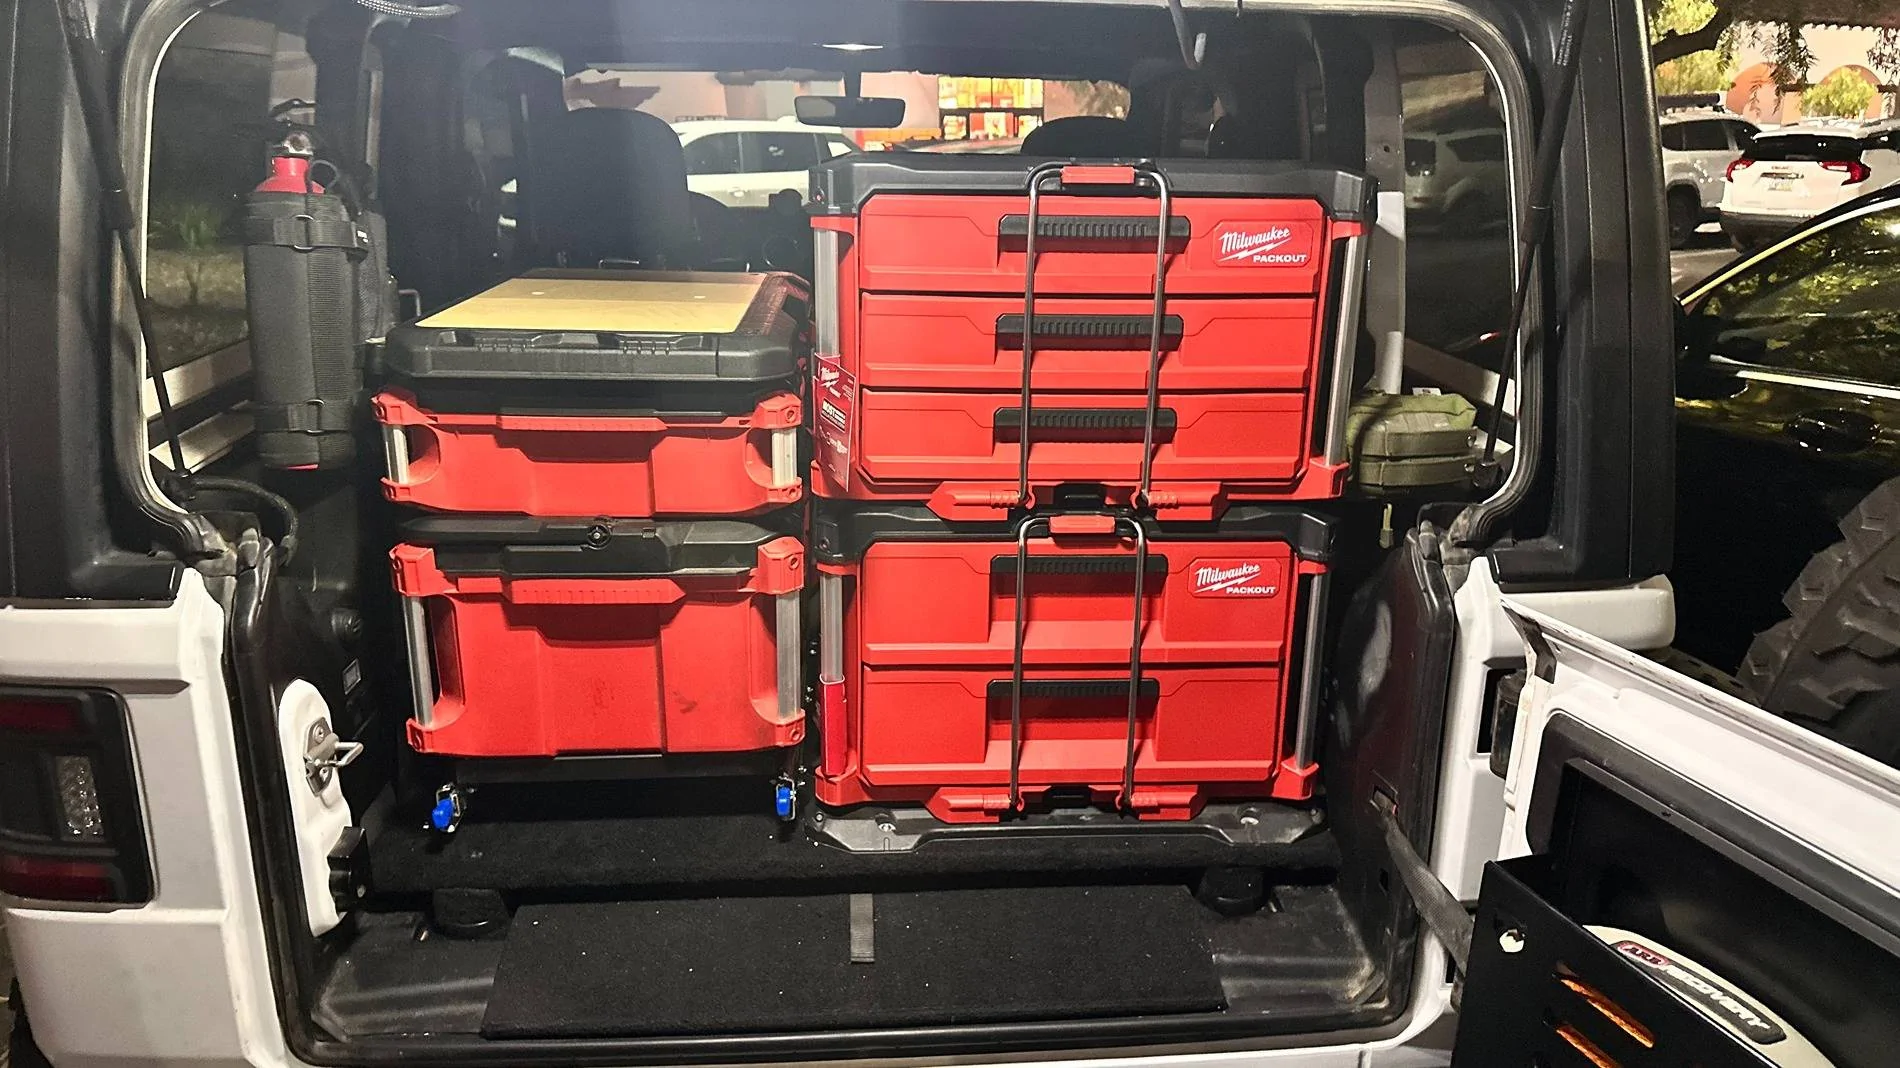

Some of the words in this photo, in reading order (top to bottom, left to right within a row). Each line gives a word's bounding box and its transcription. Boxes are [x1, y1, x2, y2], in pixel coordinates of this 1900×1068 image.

[1219, 226, 1291, 254] Milwaukee
[1253, 254, 1307, 263] PACKOUT
[1194, 563, 1261, 587] Milwaukee
[1226, 586, 1276, 594] PACKOUT
